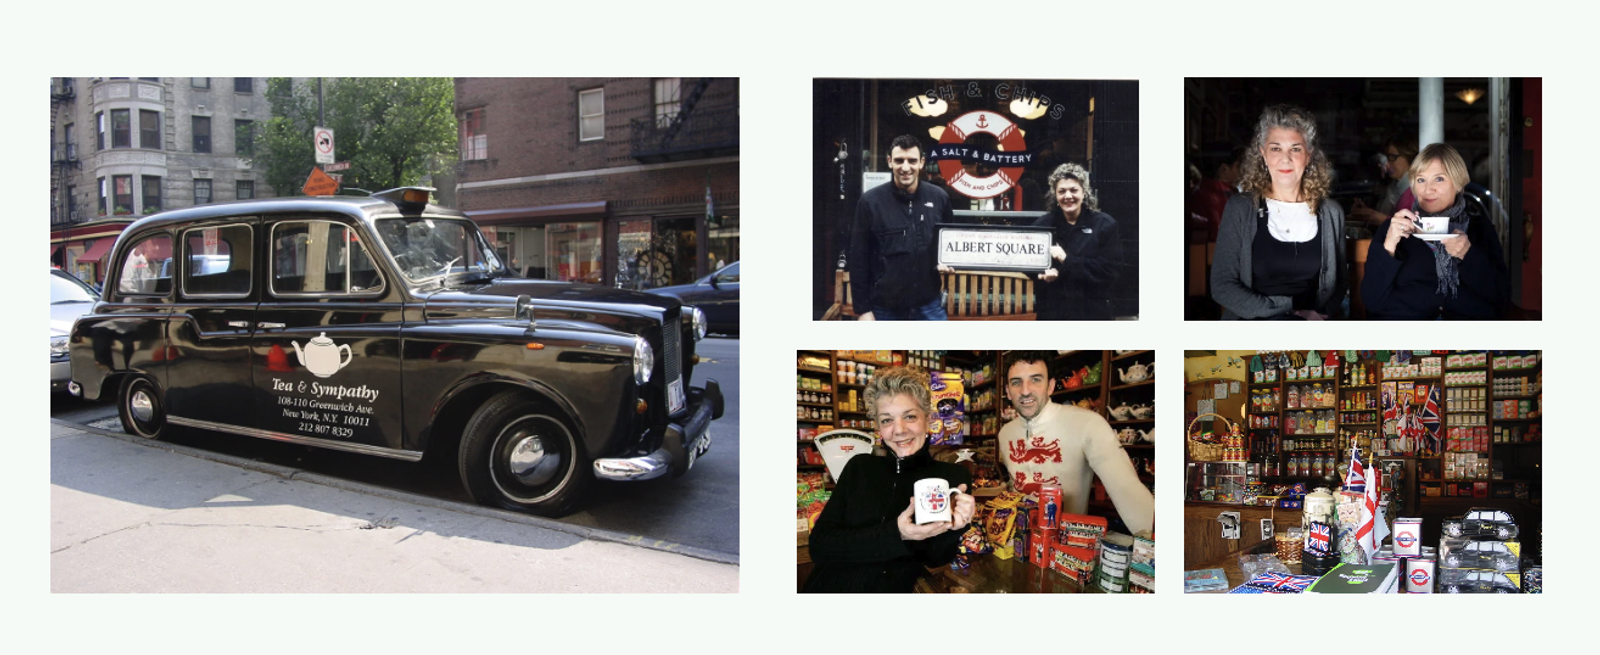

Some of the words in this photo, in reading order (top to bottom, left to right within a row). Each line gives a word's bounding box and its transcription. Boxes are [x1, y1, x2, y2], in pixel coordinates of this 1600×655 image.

[901, 85, 954, 117] FISH
[967, 81, 982, 98] &
[995, 83, 1066, 120] CHIPS
[942, 148, 969, 156] SALT
[972, 150, 979, 159] &
[983, 152, 1032, 163] BATTERY
[958, 178, 972, 189] FISH
[945, 241, 993, 253] ALBERT
[996, 242, 1045, 255] SQUARE
[272, 378, 293, 392] Tea
[297, 380, 307, 393] &
[310, 381, 379, 403] Sympathy
[278, 396, 308, 407] 108-110
[309, 400, 354, 413] Greenwich
[355, 404, 374, 414] Ave.
[282, 408, 299, 418] New
[300, 410, 320, 422] York,
[322, 413, 338, 423] N.Y.
[343, 415, 370, 427] 10011
[298, 422, 313, 432] 212
[314, 425, 330, 435] 807
[331, 426, 353, 438] 8329
